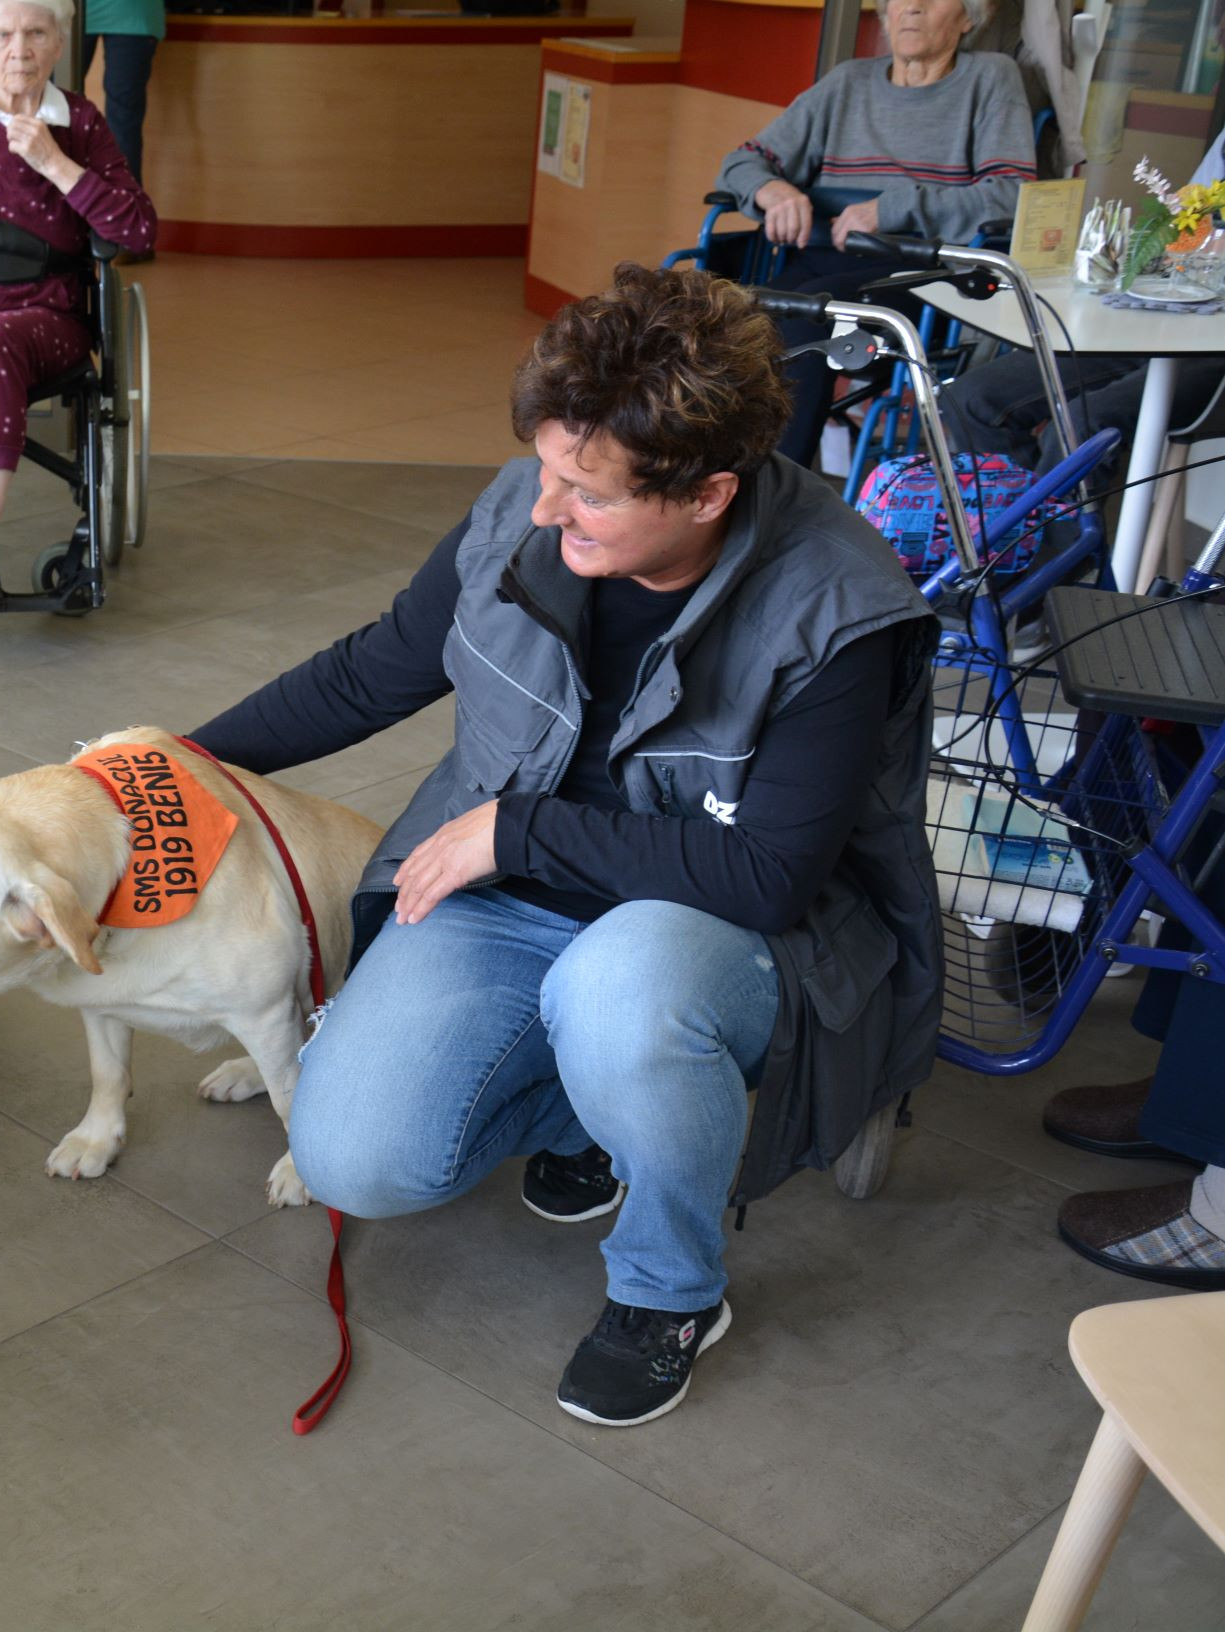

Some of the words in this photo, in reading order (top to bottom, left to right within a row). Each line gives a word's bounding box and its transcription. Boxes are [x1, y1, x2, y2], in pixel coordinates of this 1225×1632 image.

[96, 753, 157, 851] DONACIJE
[130, 751, 188, 827] BENI5
[133, 858, 162, 913] SMS
[160, 836, 198, 898] 1919
